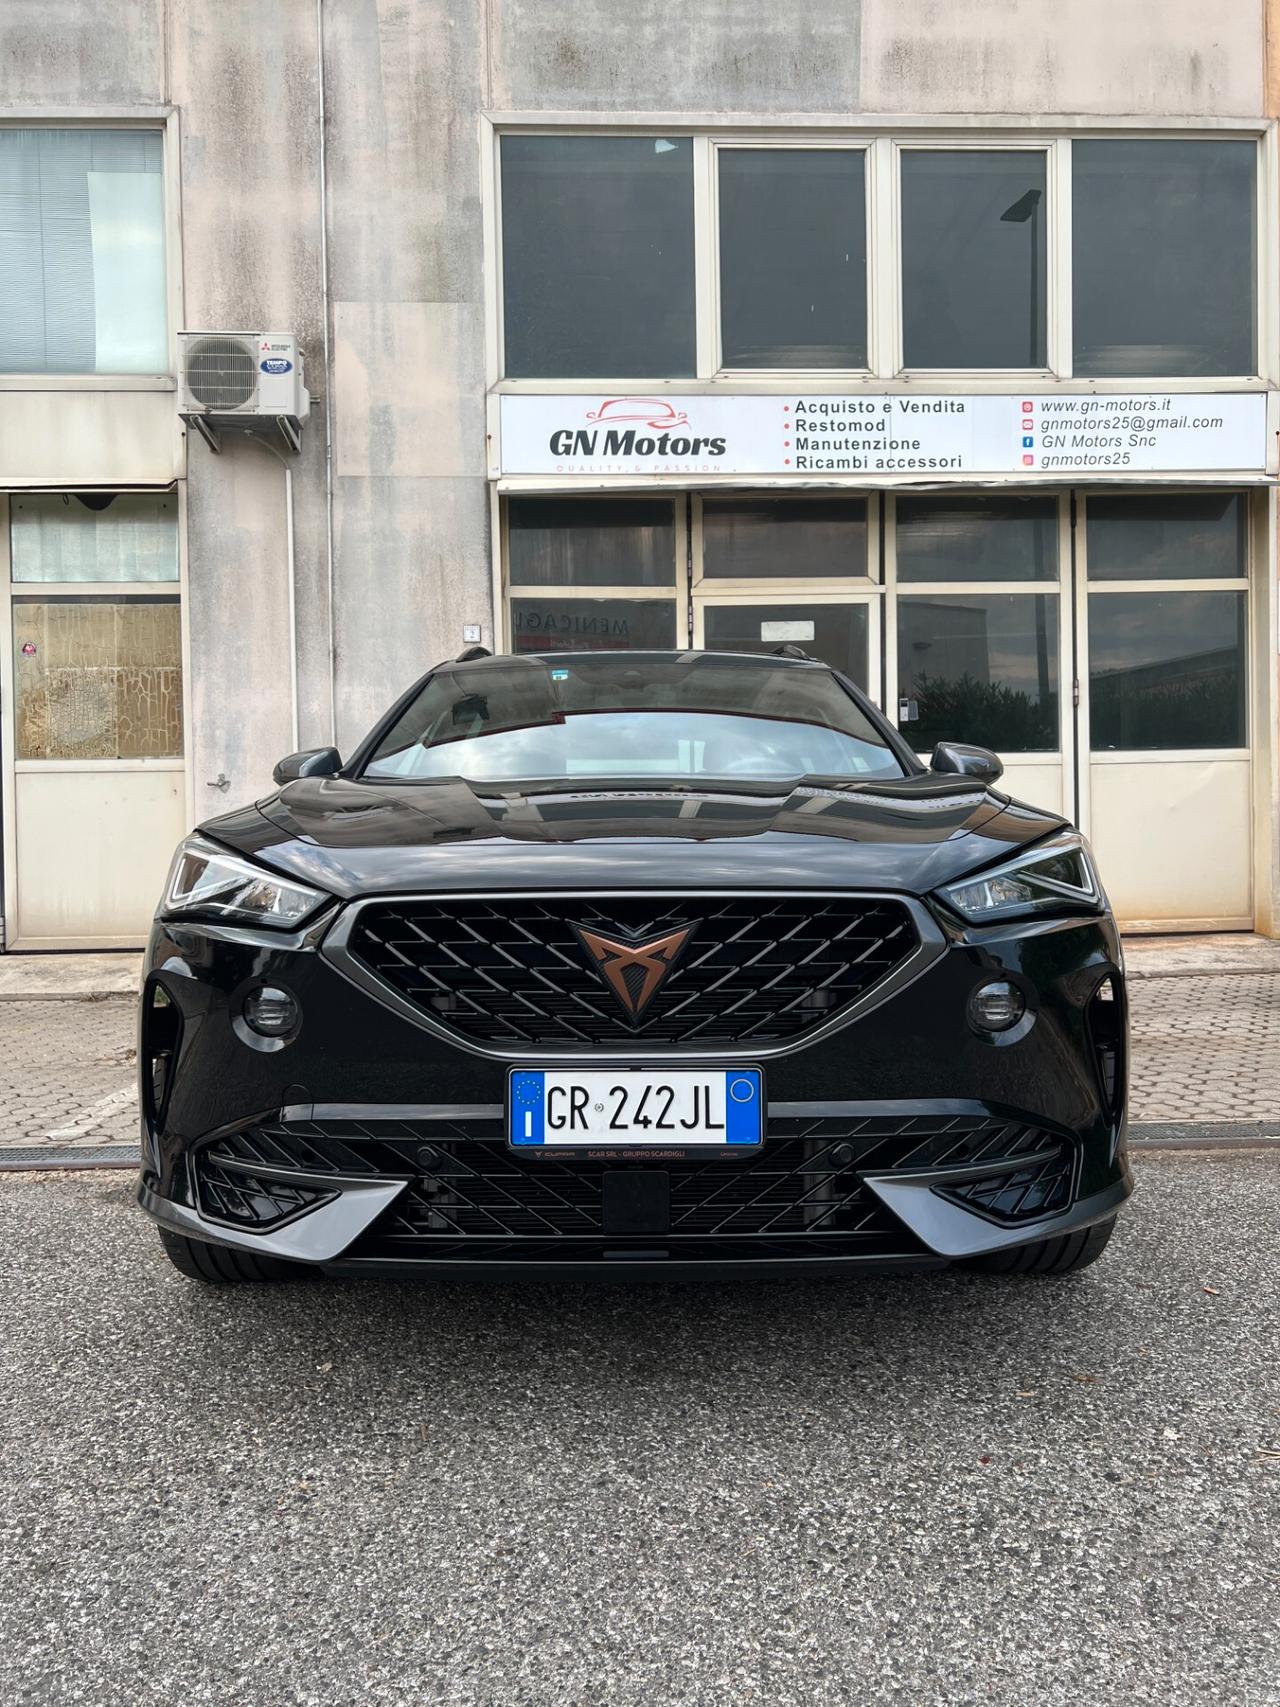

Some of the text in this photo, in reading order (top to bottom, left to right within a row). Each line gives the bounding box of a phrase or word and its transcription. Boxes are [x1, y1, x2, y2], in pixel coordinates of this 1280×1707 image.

[795, 401, 965, 417] Acquisto e Vendita
[1041, 398, 1171, 414] www.gn-motors.it
[796, 419, 885, 432] Restomod
[1041, 416, 1223, 433] gnmotors25@gmail.com
[550, 430, 727, 456] GN Motors
[796, 437, 920, 450] Manutenzione
[1042, 434, 1157, 448] GN Motors Snc
[654, 464, 721, 472] PASSION
[796, 455, 962, 469] Ricambi accessori
[1041, 452, 1131, 468] gnmotors25
[547, 1085, 725, 1130] GR 242JL
